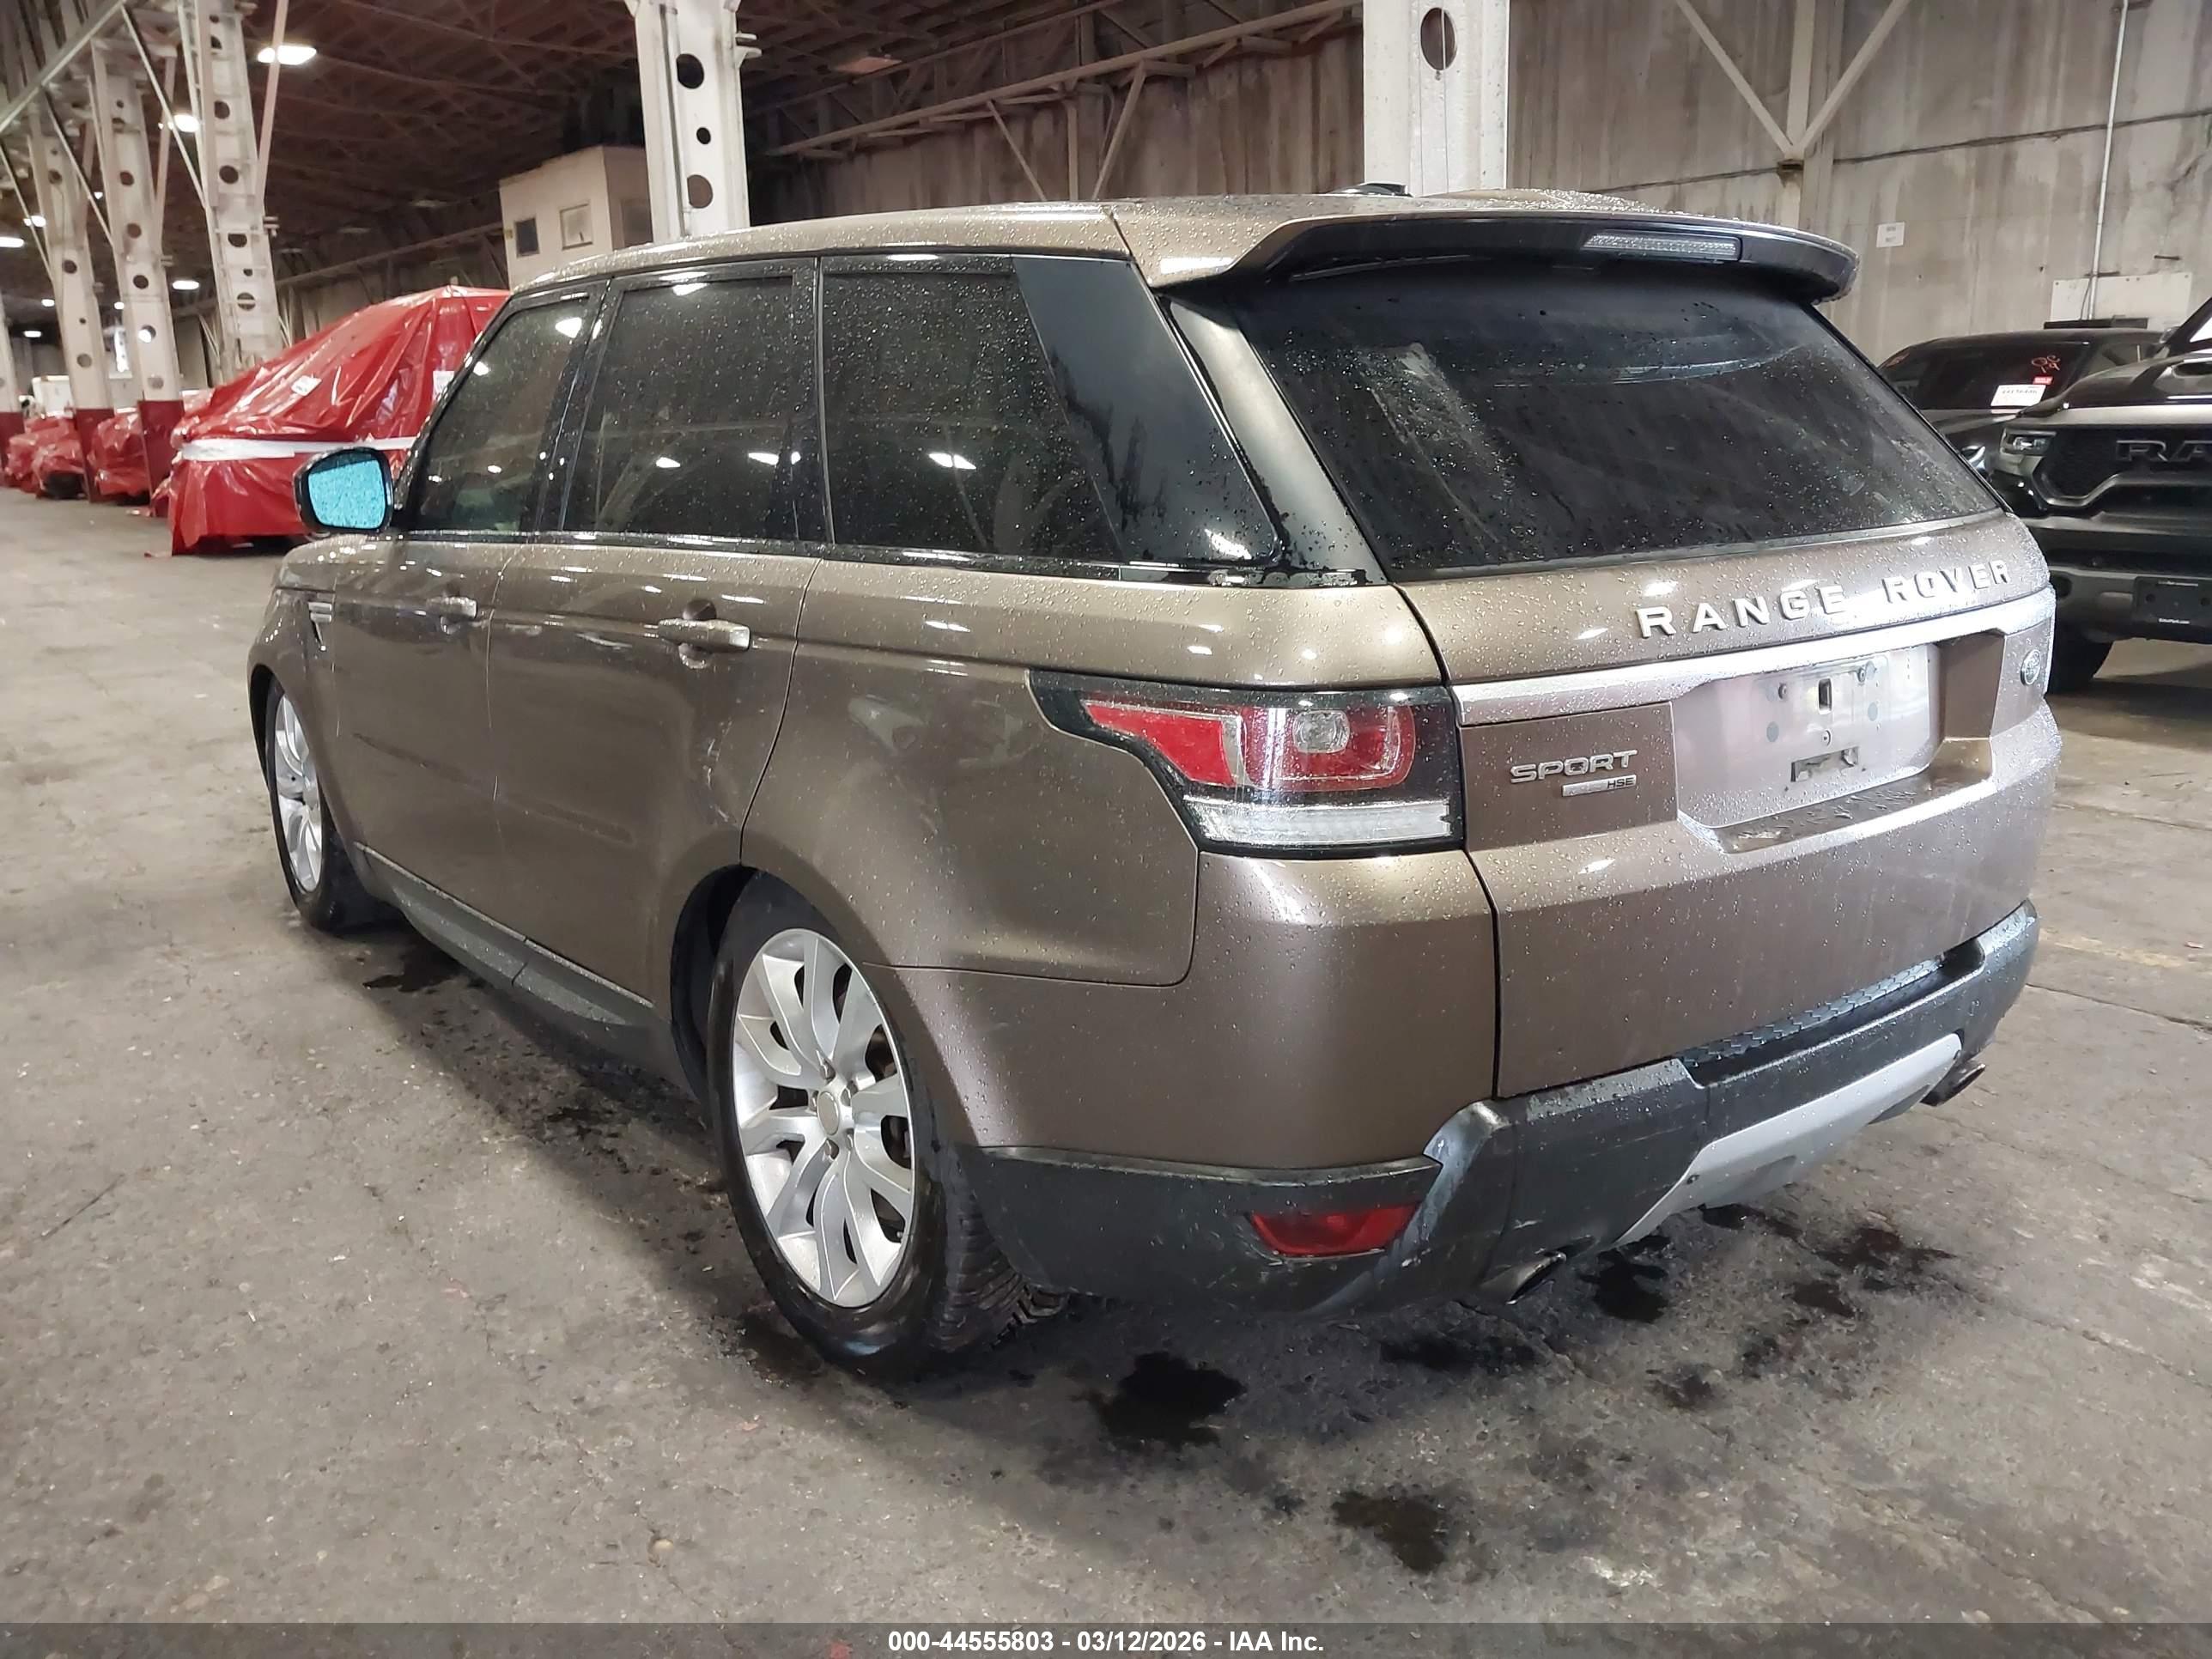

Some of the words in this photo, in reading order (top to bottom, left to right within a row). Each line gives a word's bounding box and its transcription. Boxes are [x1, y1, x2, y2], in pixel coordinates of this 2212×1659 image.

[1635, 585, 1846, 638] RANGE
[1881, 559, 2012, 604] ROVER
[1510, 749, 1638, 784] SPORT
[1607, 776, 1635, 789] HSE
